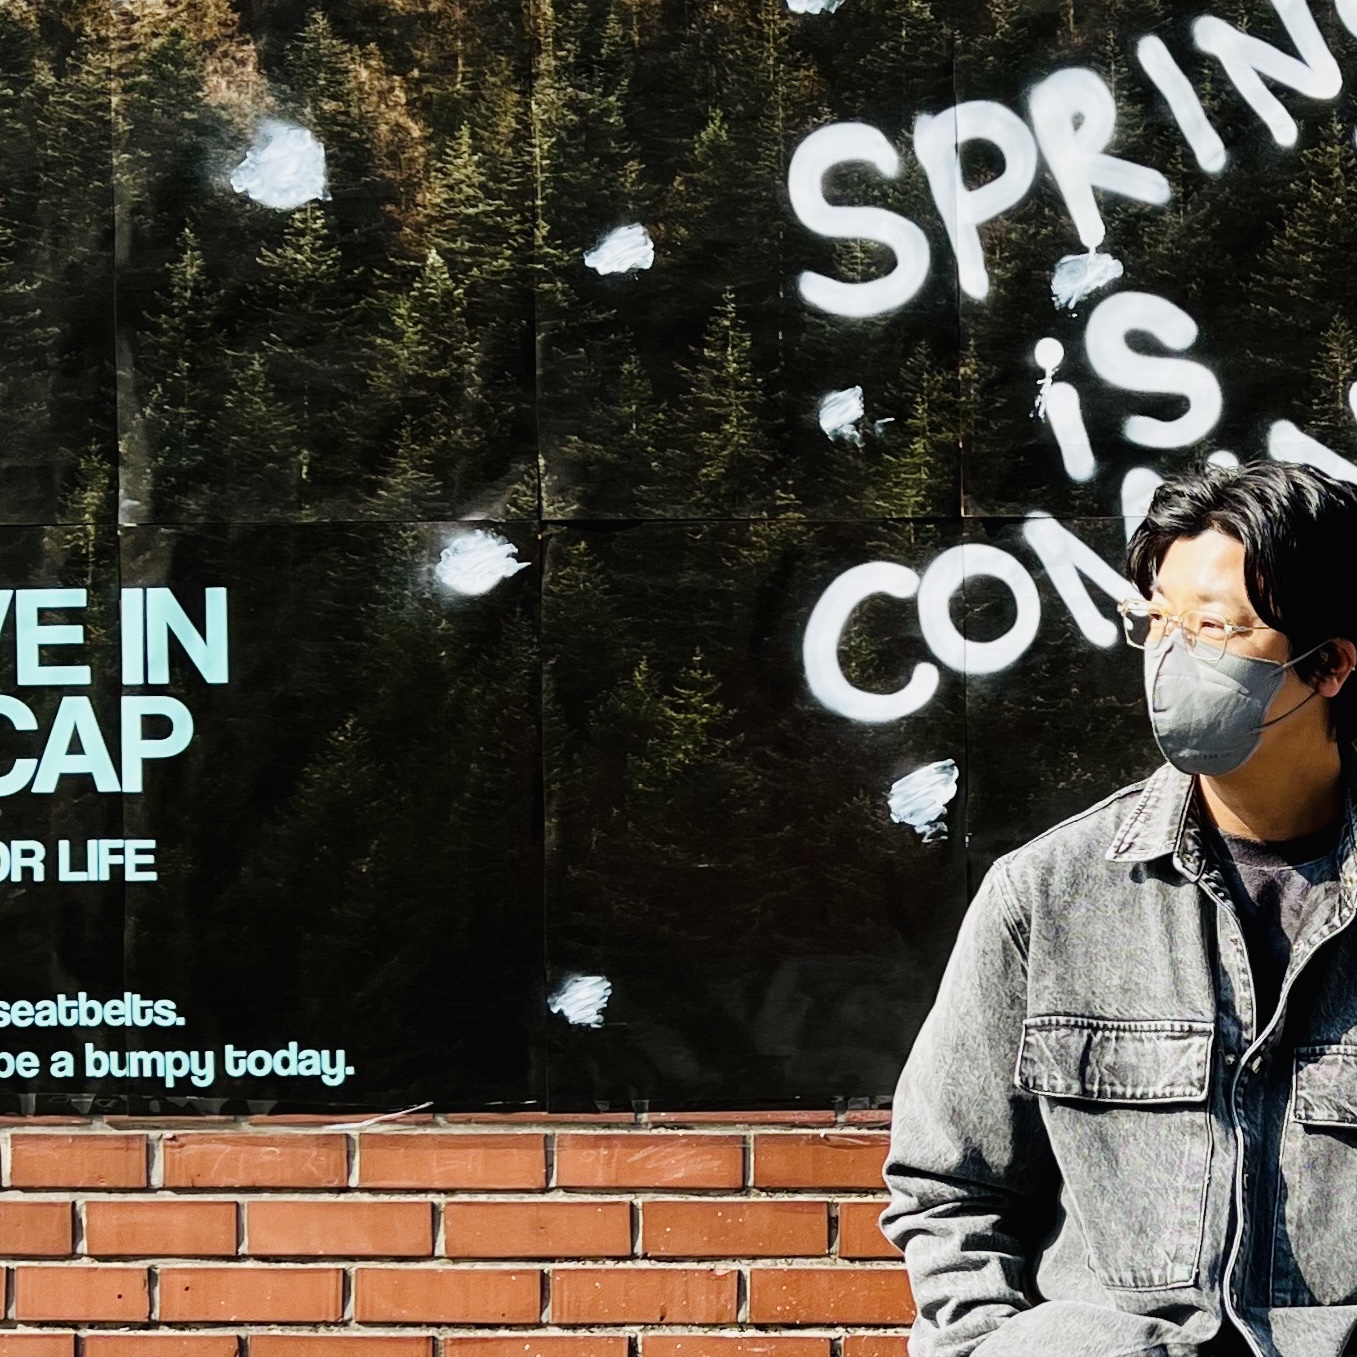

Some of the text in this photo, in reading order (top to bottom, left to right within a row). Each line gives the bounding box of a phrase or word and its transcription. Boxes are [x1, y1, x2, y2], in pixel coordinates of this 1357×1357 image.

[0, 586, 229, 686] E IN
[0, 838, 158, 883] R LIFE
[49, 1050, 75, 1078] a
[85, 1042, 215, 1088] bumpy
[224, 1041, 355, 1087] today.
